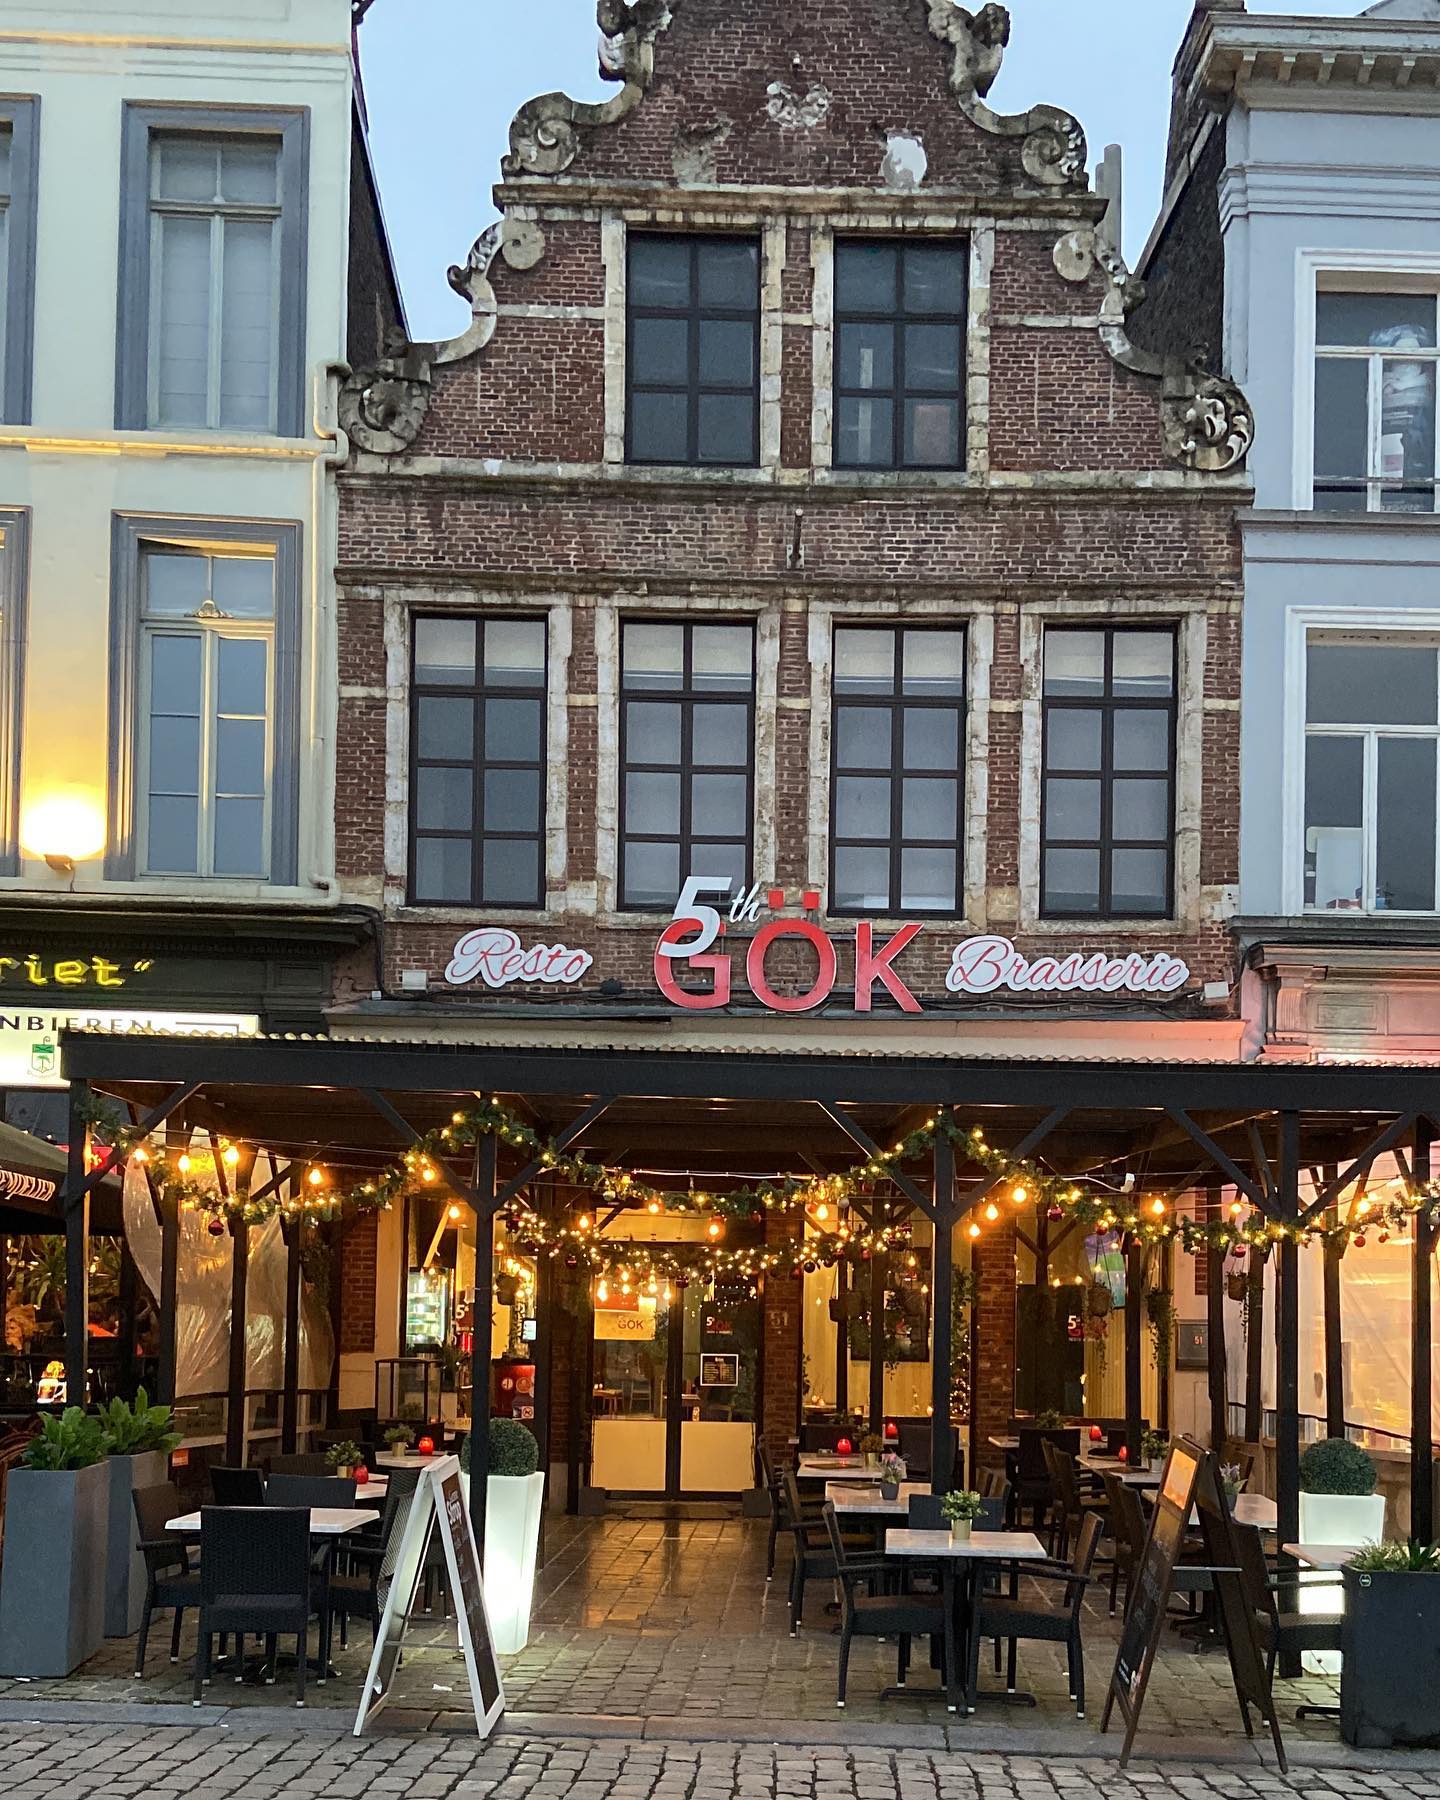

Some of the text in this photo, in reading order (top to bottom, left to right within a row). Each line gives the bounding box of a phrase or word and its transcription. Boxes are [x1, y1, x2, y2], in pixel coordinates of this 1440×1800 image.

[658, 876, 761, 957] 5th
[450, 932, 586, 981] Resto
[952, 939, 1182, 987] Brasserie
